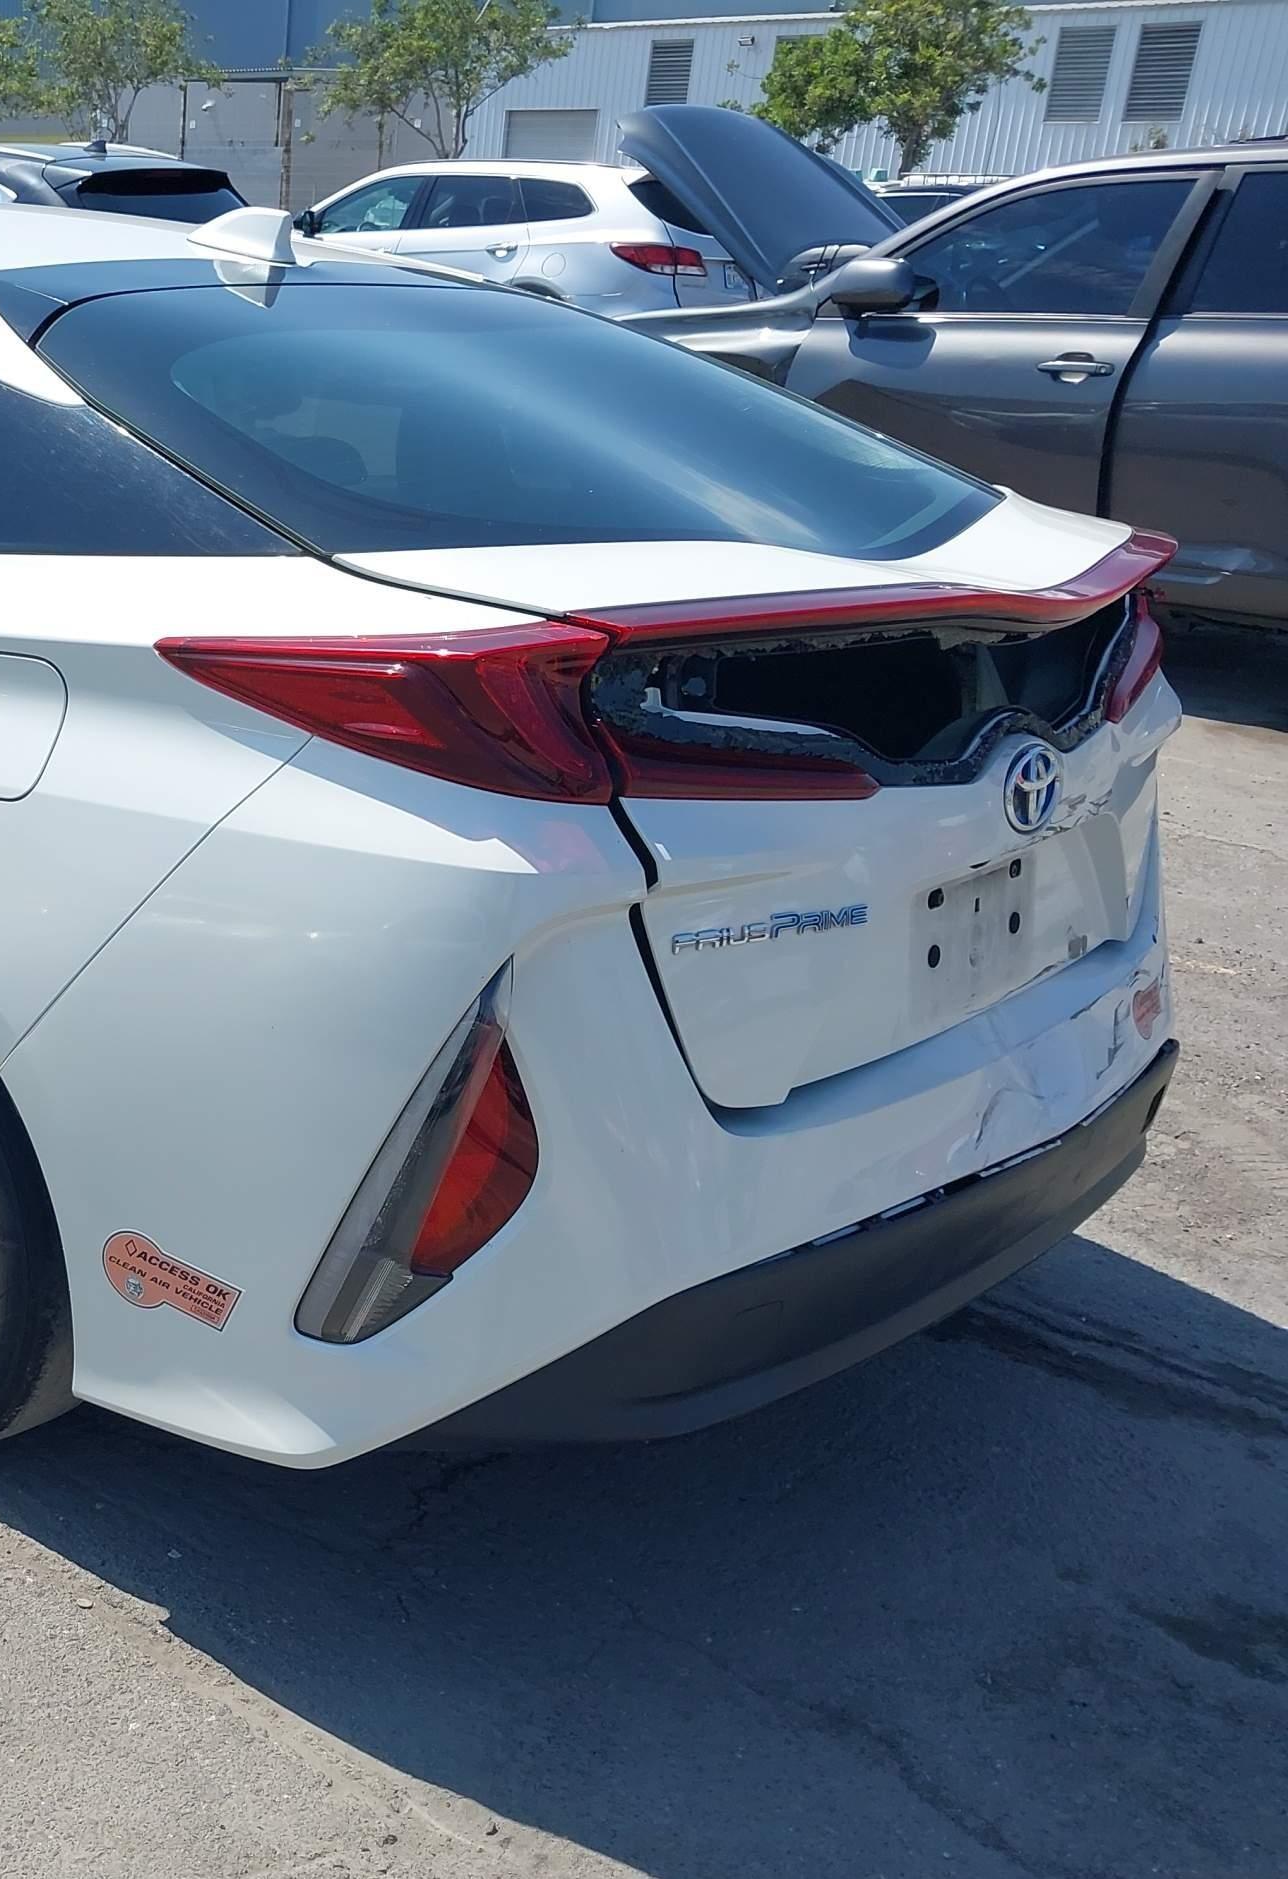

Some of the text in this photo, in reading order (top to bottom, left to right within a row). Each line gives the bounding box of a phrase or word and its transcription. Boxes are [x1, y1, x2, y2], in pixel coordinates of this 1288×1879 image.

[672, 903, 869, 955] PRIUS PRIME
[108, 1255, 148, 1278] CLEAN
[149, 1276, 171, 1290] AIR
[174, 1287, 224, 1316] VEHICLE
[136, 1250, 231, 1301] ACCESS OK
[182, 1284, 226, 1309] CALIFORNIA
